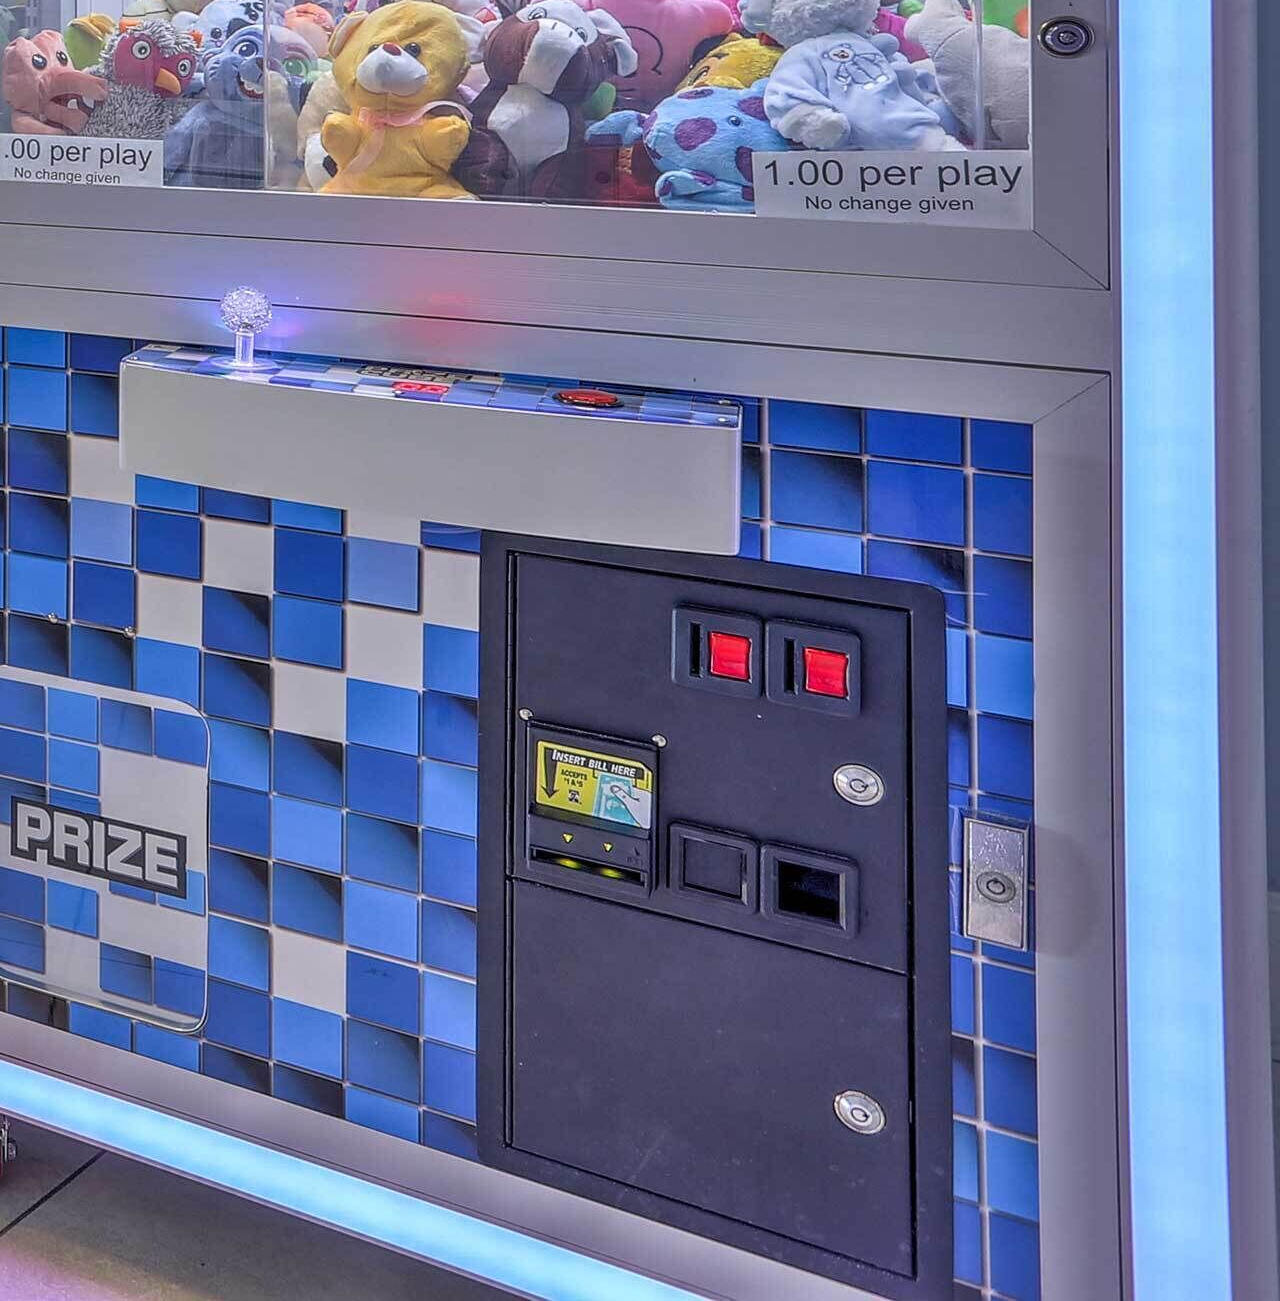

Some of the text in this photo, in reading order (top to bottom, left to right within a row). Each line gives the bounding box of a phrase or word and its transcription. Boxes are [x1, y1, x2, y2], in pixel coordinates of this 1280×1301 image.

[50, 144, 91, 166] per
[99, 143, 152, 171] play
[14, 167, 121, 185] No change given
[764, 159, 1022, 193] 1.00 per play
[805, 196, 974, 214] No change given
[552, 749, 636, 778] INSERT BILL HERE
[561, 769, 588, 781] ACCEPTS
[16, 802, 180, 891] PRIZE
